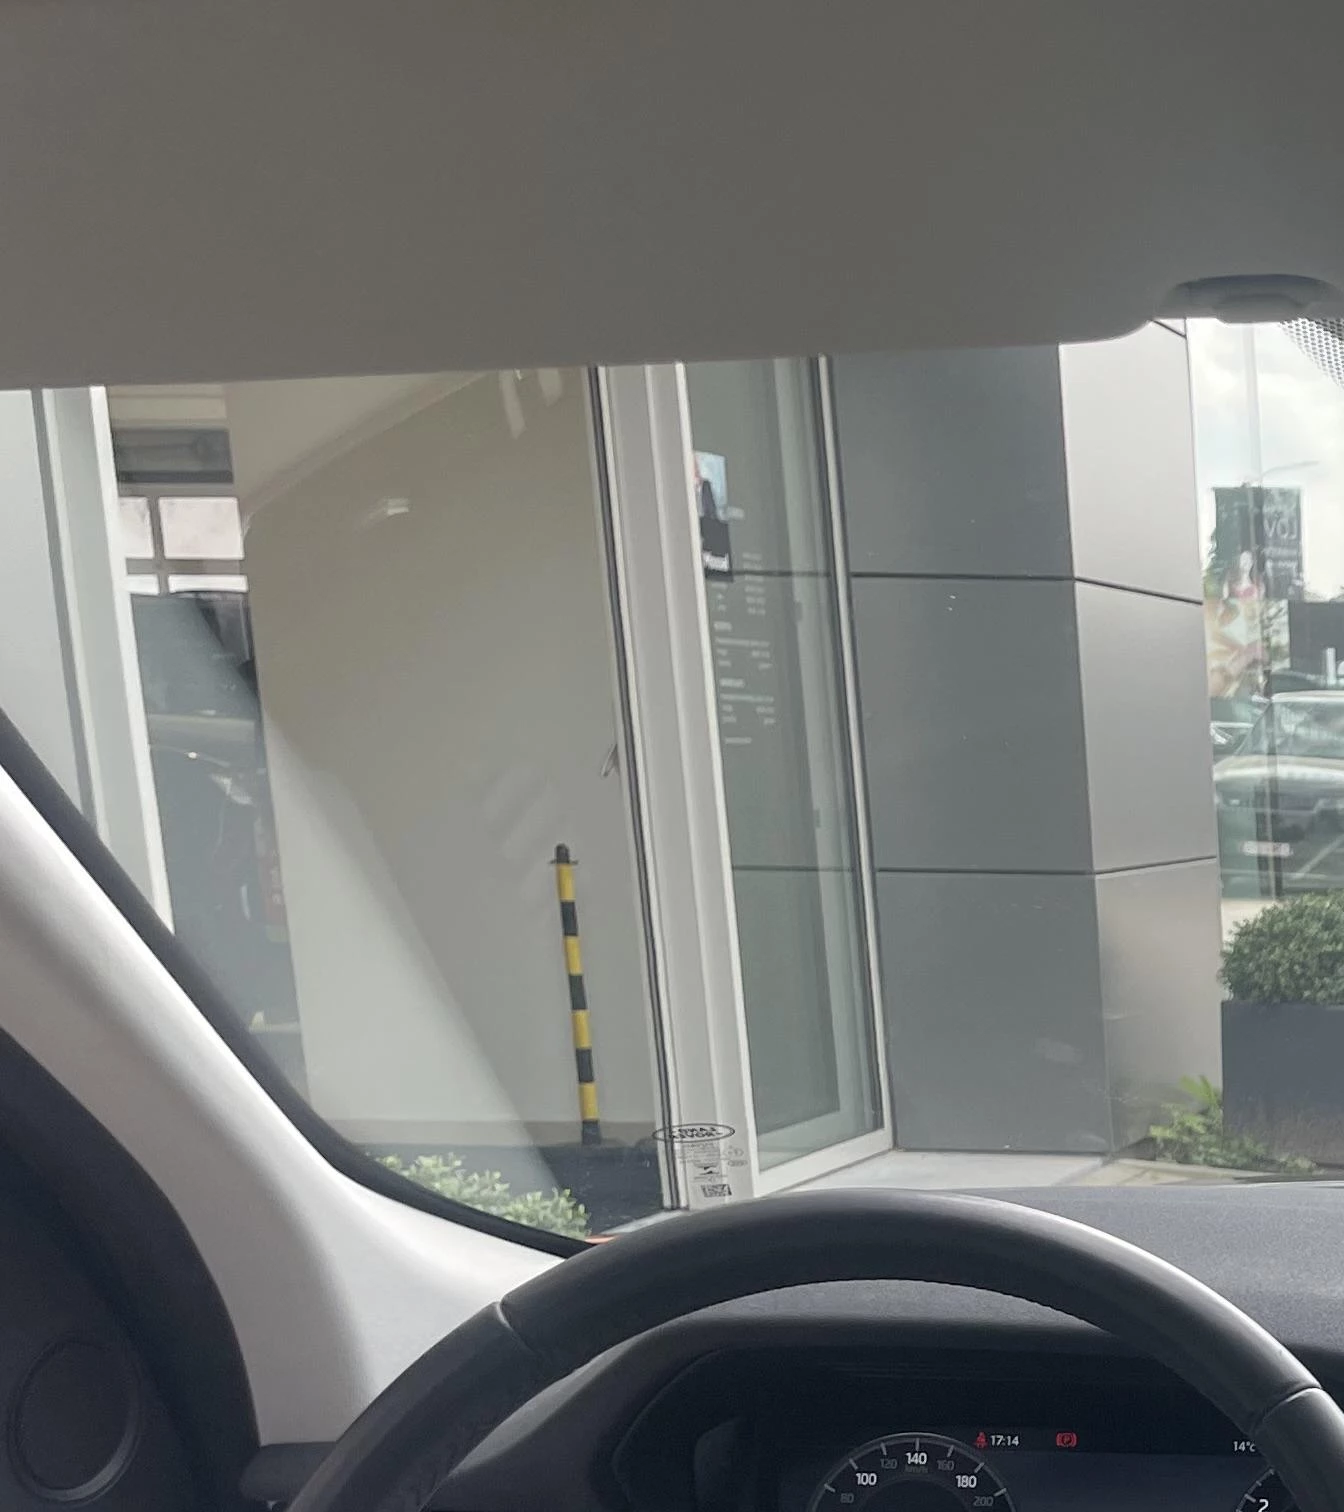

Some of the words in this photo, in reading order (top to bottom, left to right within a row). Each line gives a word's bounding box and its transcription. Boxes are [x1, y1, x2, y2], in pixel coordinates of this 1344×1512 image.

[990, 1435, 1019, 1447] 17:14
[905, 1452, 927, 1465] 140
[855, 1473, 877, 1486] 100
[955, 1475, 977, 1488] 180
